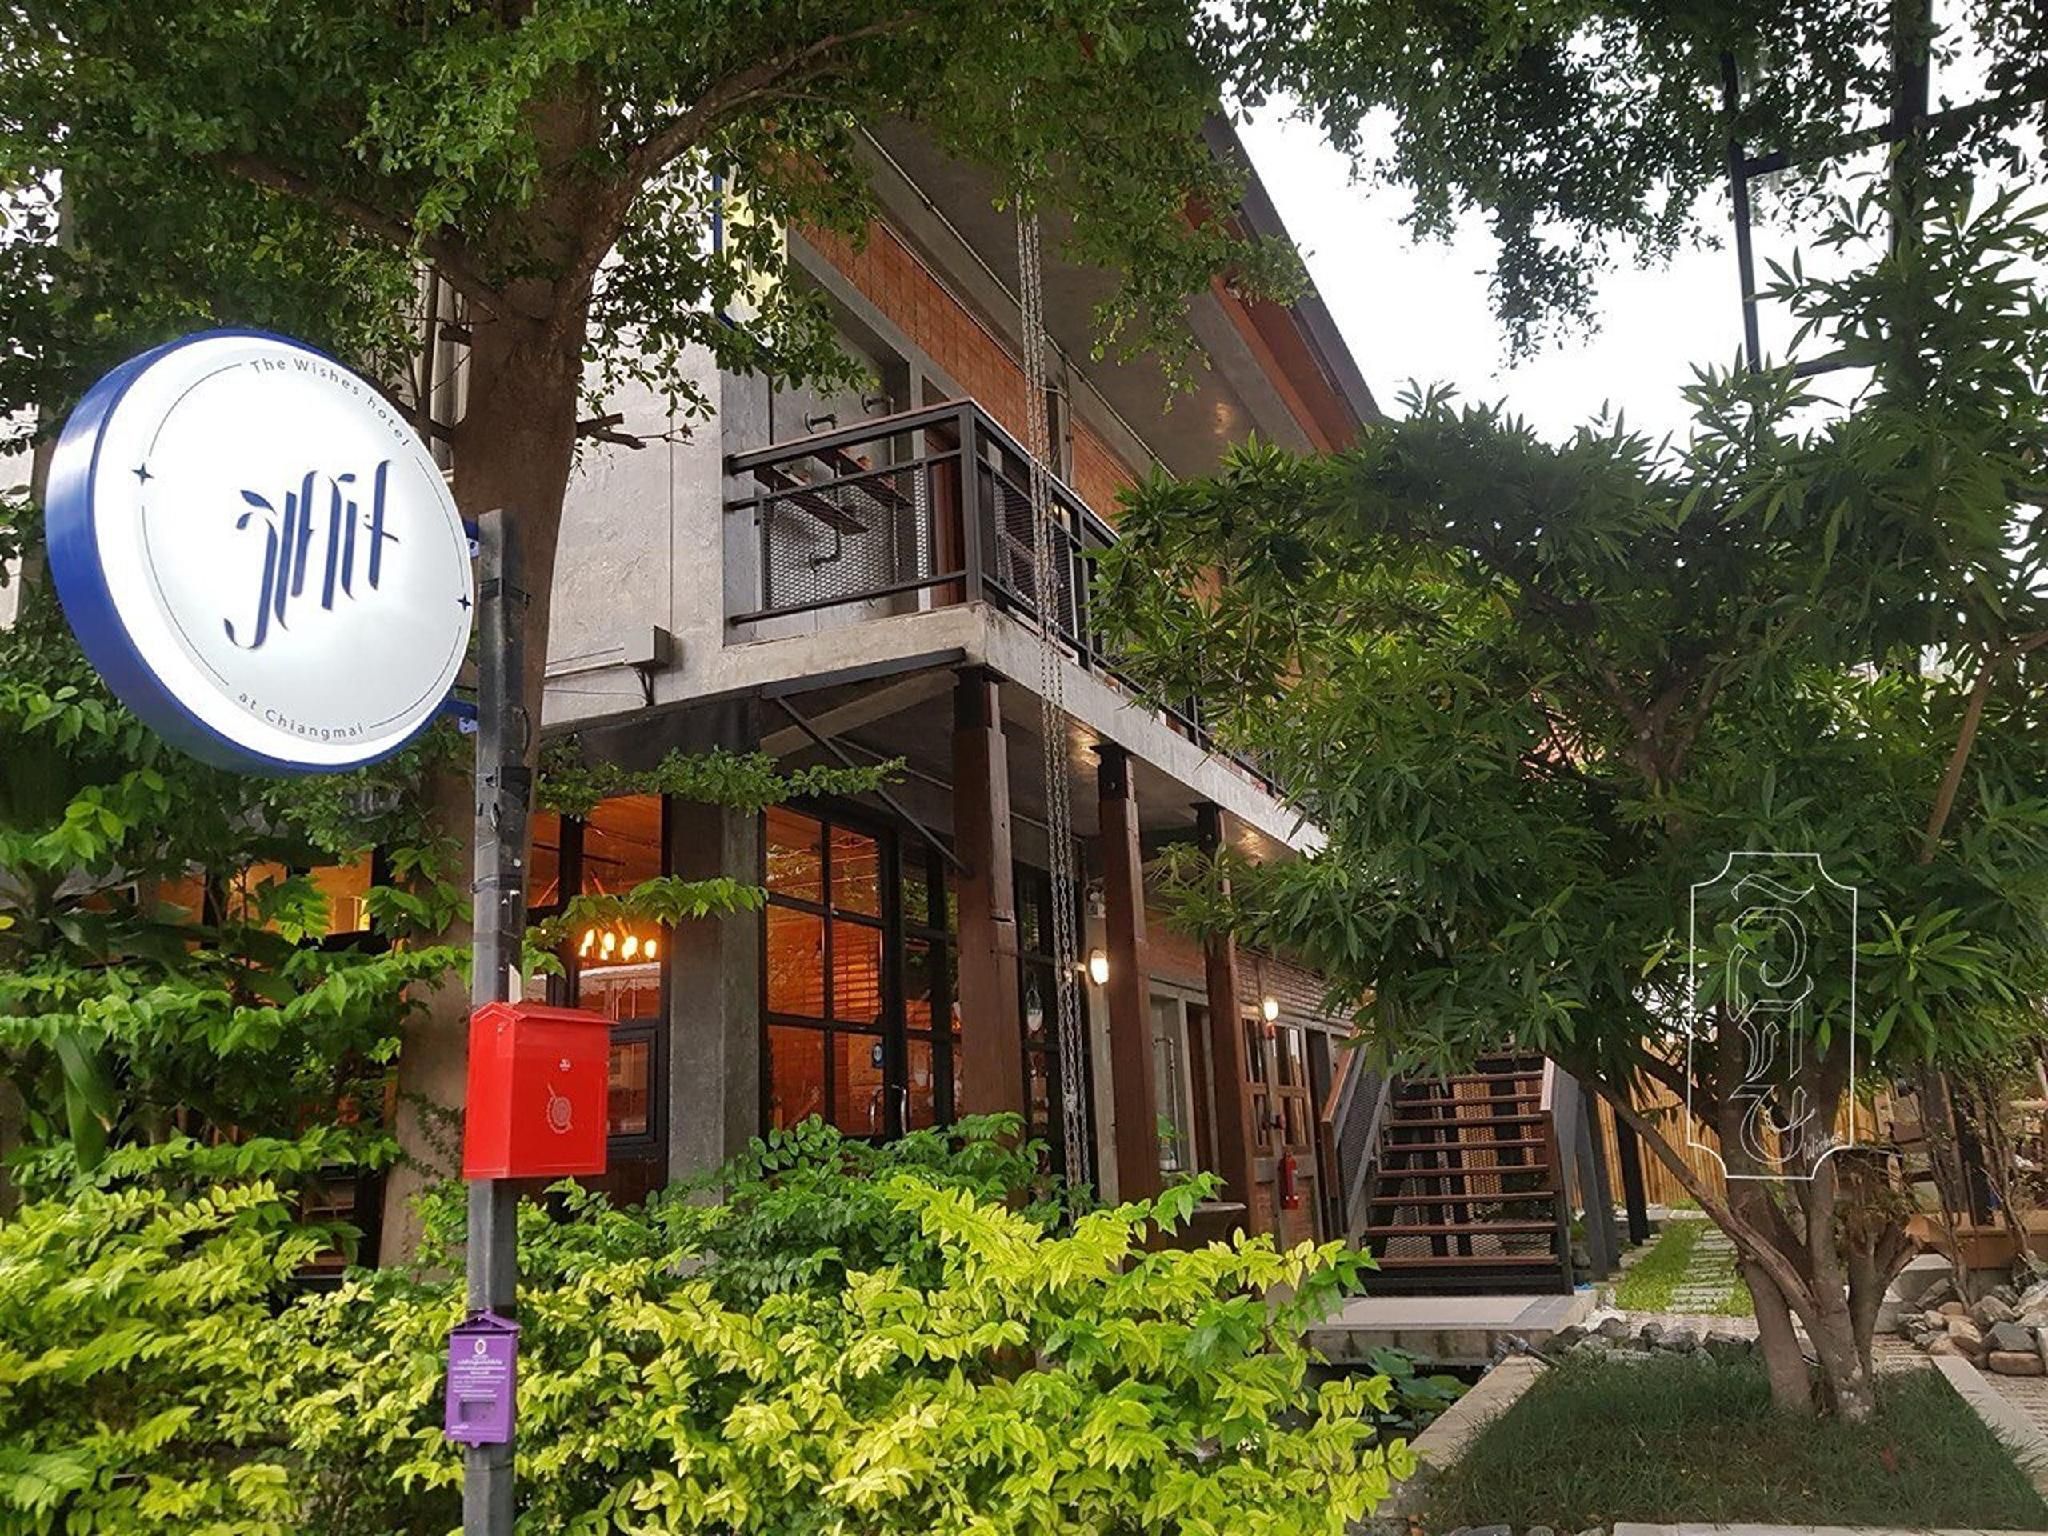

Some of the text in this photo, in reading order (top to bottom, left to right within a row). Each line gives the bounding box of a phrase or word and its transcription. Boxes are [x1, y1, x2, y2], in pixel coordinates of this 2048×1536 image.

[250, 357, 411, 446] The Wishes hotel
[239, 693, 363, 741] at Chiangmai
